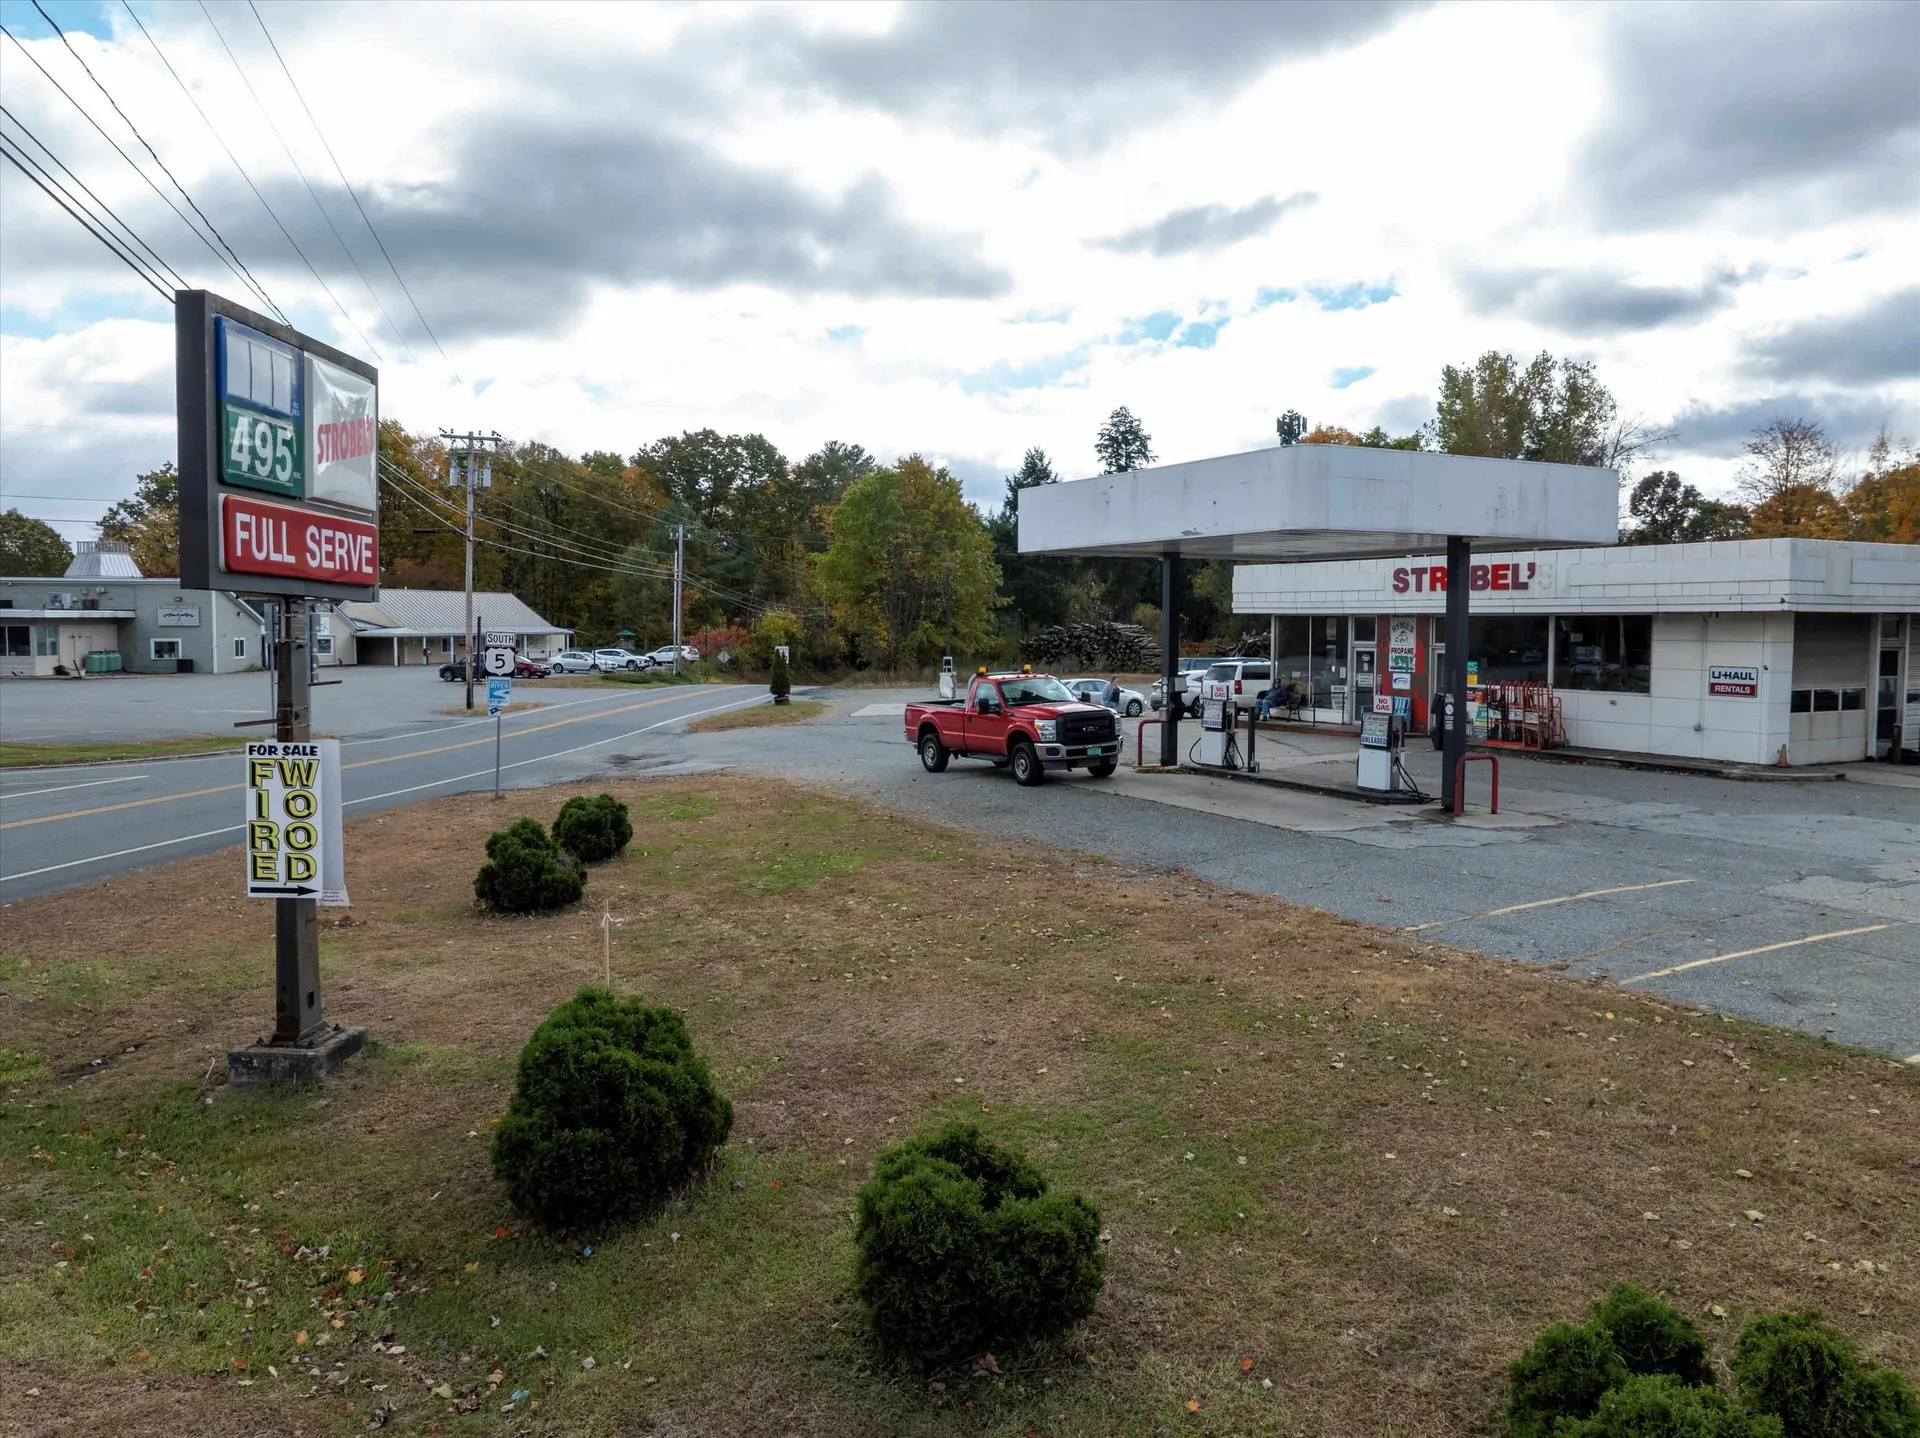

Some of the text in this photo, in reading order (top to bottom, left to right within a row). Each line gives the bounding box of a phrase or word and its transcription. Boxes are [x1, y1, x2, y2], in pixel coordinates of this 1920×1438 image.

[230, 415, 294, 482] 495
[235, 512, 373, 574] FULL SERVE
[488, 634, 514, 644] SOUTH
[1390, 647, 1415, 655] PROPANE
[495, 654, 506, 669] 5
[1711, 670, 1755, 681] U-HAUL
[1714, 685, 1751, 694] RENTALS
[1362, 736, 1386, 745] UNLEADED
[248, 744, 318, 757] FOR SALE
